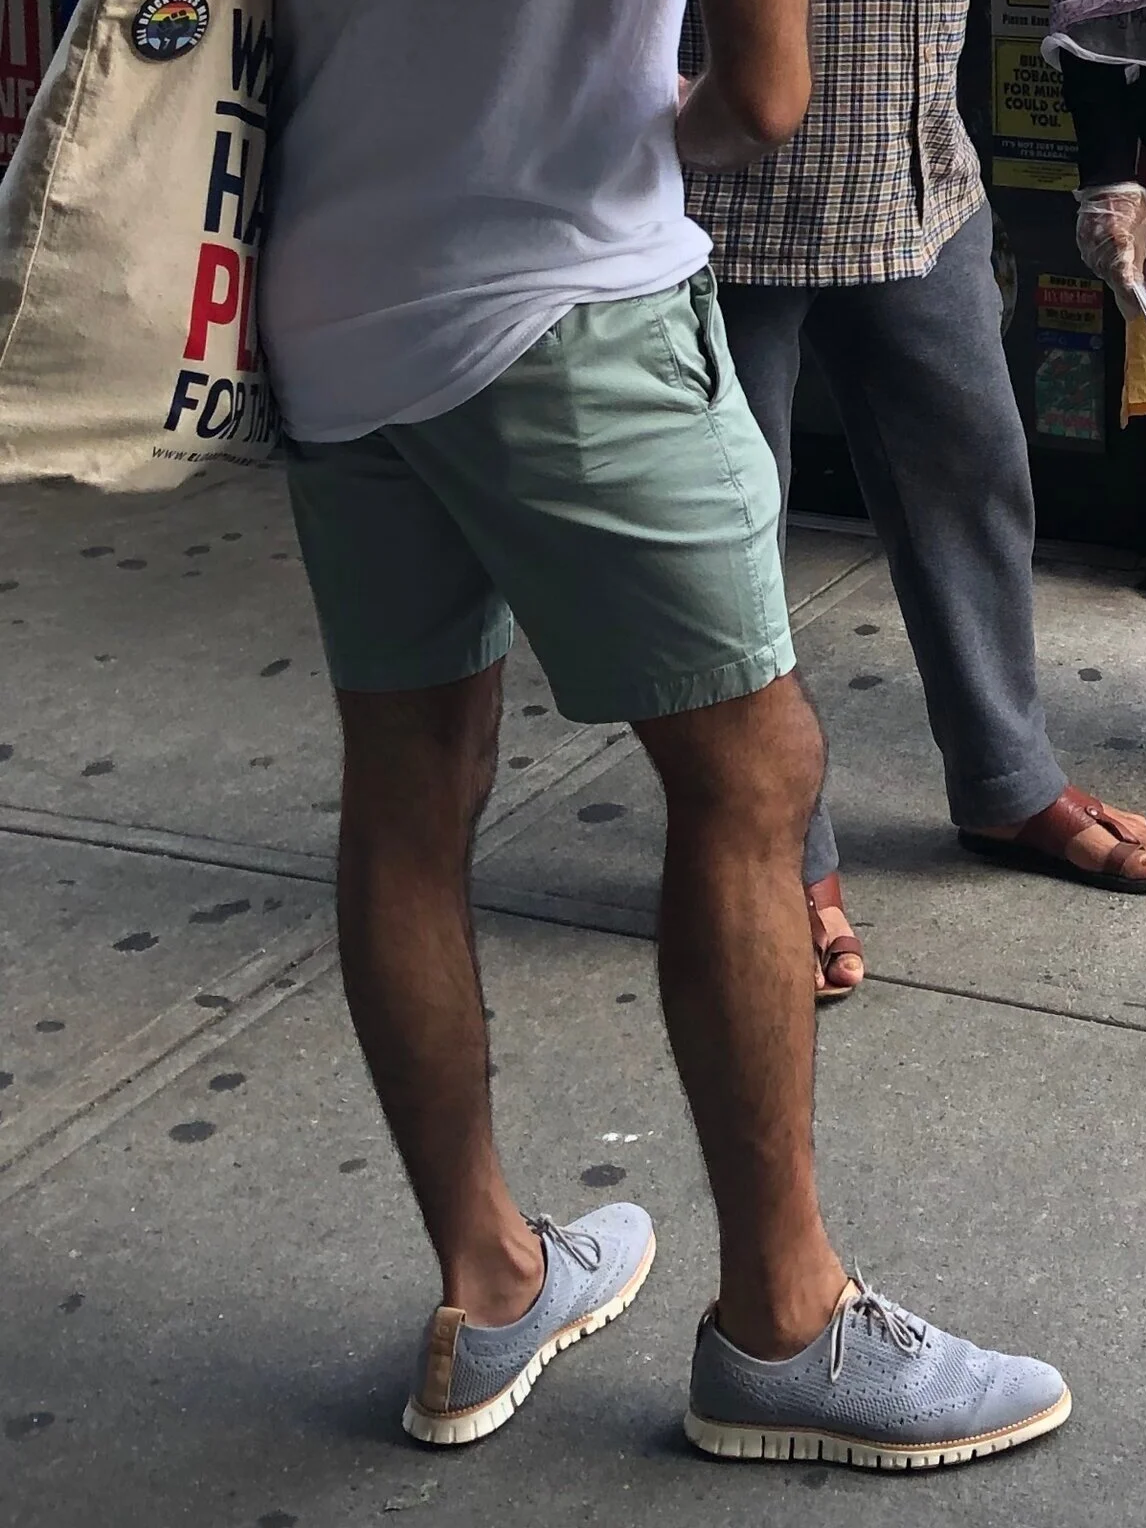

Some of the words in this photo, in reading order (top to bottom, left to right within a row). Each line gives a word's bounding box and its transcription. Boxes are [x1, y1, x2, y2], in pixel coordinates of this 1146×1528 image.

[136, 28, 148, 46] ALL
[190, 5, 208, 46] MATTER
[1003, 81, 1031, 97] FOR
[1004, 96, 1049, 112] COULD
[1029, 113, 1062, 128] YOU.
[1017, 140, 1034, 149] NOT
[1035, 141, 1055, 151] JUST
[1059, 289, 1074, 304] the
[183, 242, 258, 372] PL
[163, 369, 247, 440] FOR
